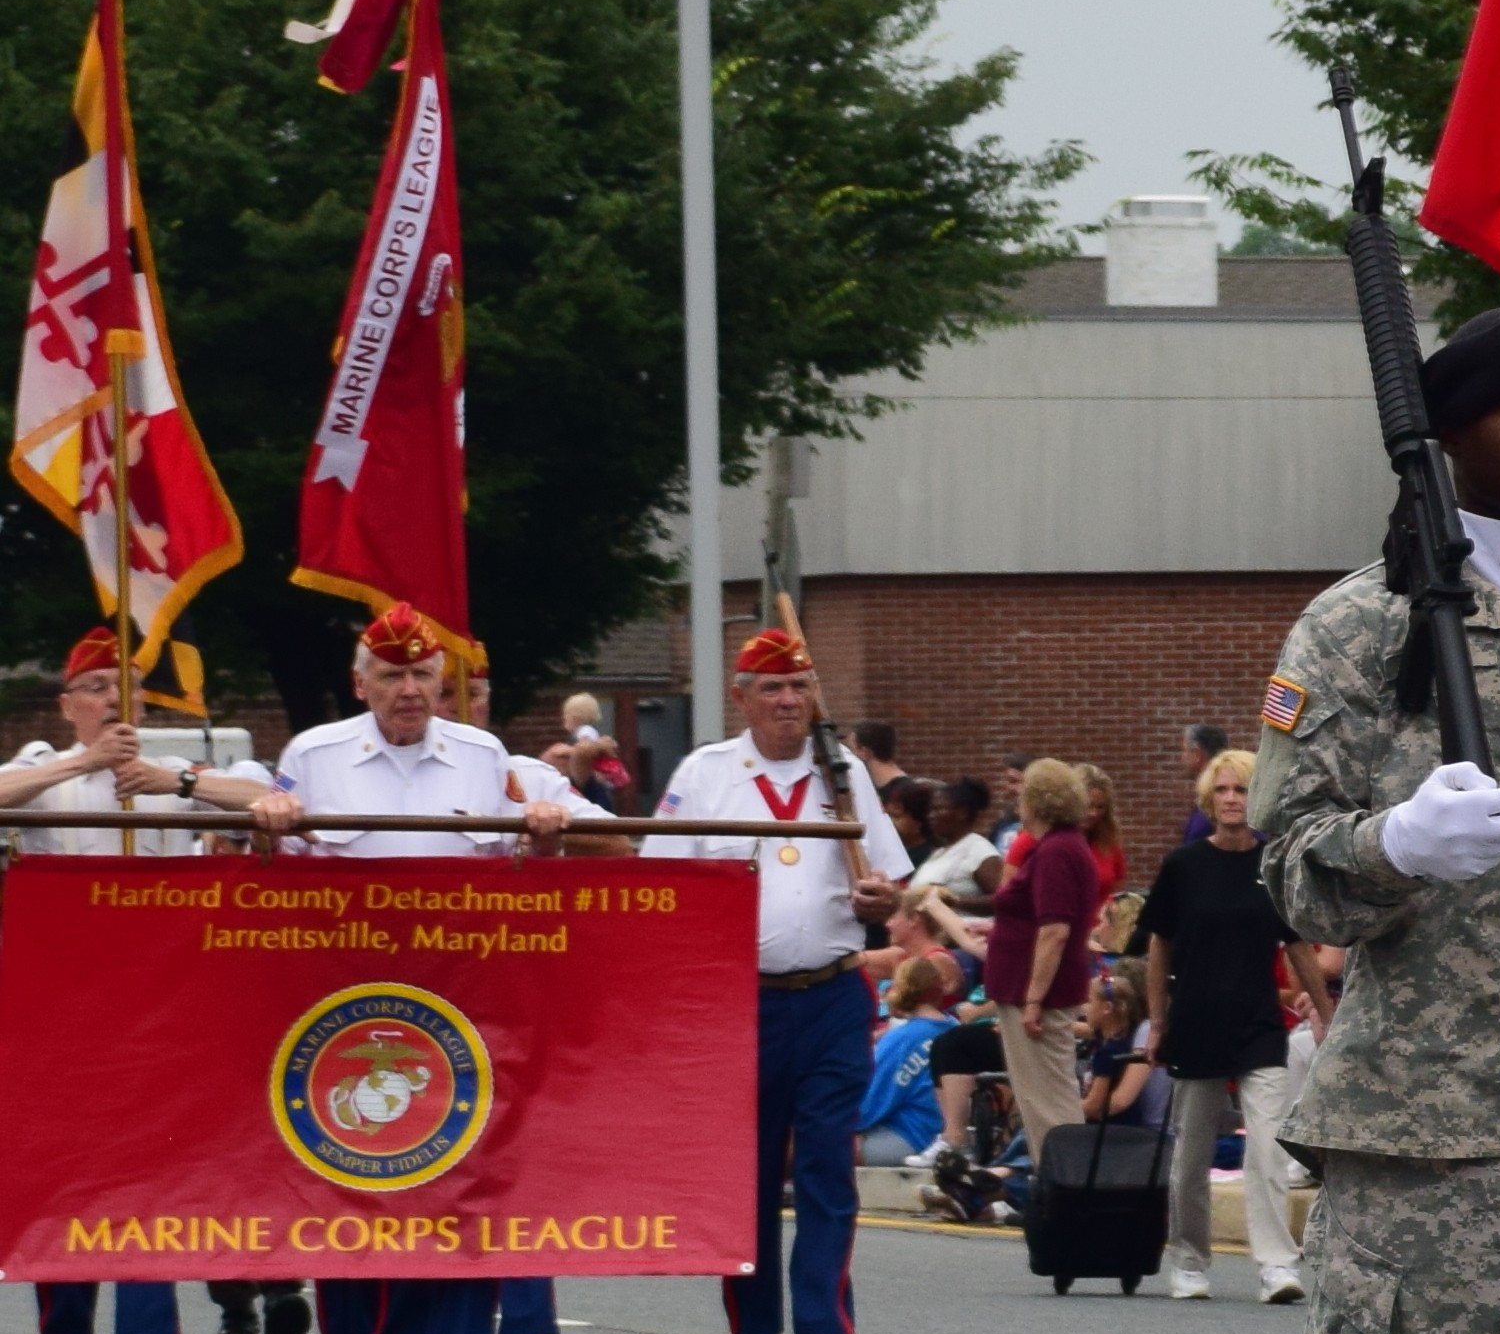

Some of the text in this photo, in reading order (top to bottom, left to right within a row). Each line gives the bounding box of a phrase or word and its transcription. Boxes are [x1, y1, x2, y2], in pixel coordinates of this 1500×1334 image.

[330, 323, 386, 436] MARINE
[368, 220, 418, 319] CORPS
[402, 93, 440, 215] LEAGUE
[89, 880, 677, 917] Harford County Detachment #1198
[201, 920, 569, 960] Jarrettsville, Maryland
[291, 999, 472, 1074] MARINE CORPS LEAGUE
[315, 1135, 451, 1174] SEMPER FIDELIS
[67, 1215, 679, 1253] MARINE CORPS LEAGUE
